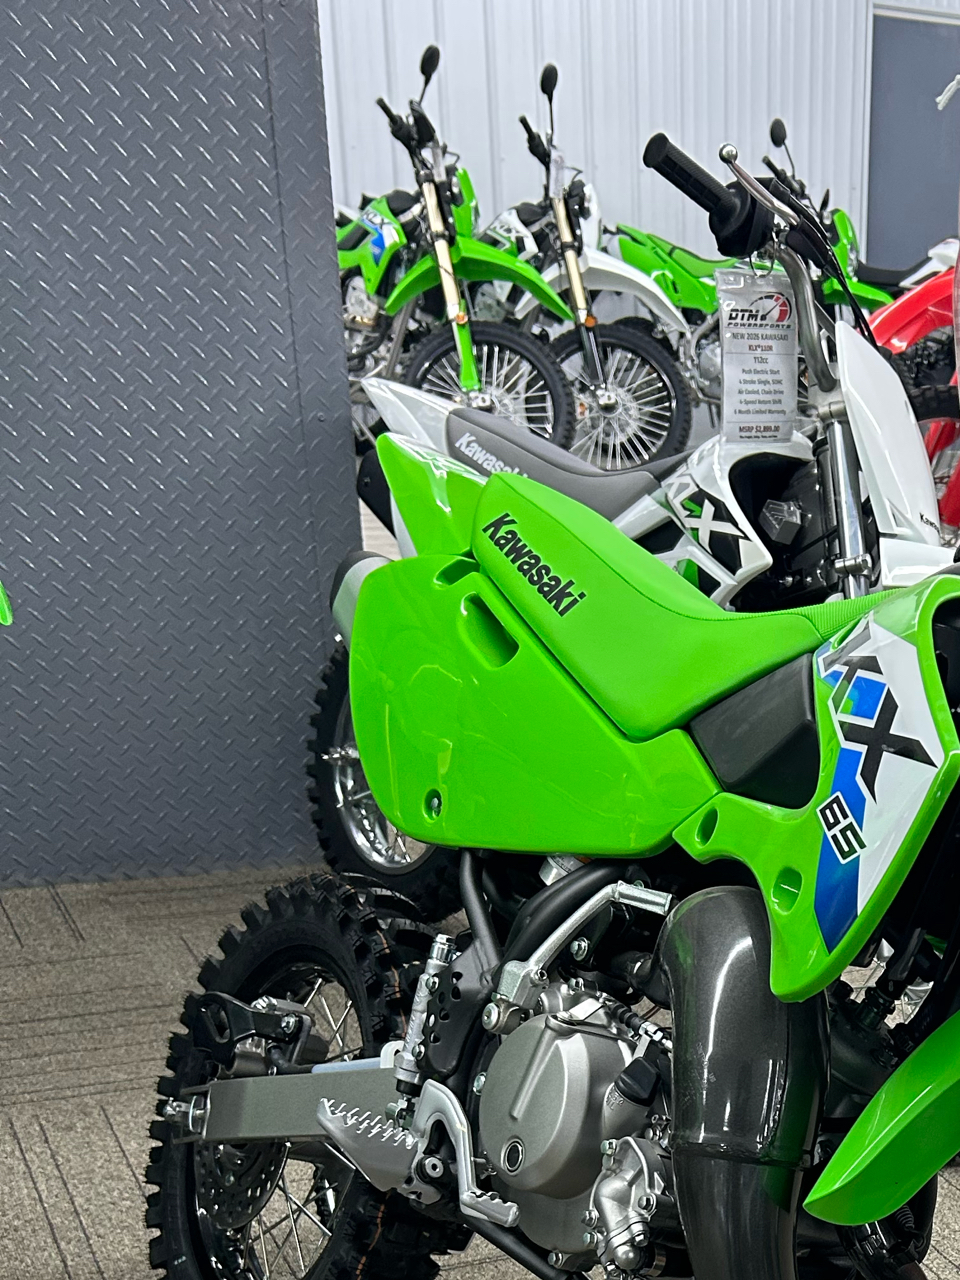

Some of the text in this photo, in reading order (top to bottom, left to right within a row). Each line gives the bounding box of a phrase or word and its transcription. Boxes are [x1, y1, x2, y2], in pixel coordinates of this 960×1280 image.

[363, 208, 393, 231] KLX
[491, 220, 526, 243] KLX
[728, 308, 761, 321] DTM
[727, 321, 792, 329] POWERSPORTS
[732, 332, 746, 340] NEW
[760, 333, 789, 341] KAWASAKI
[741, 368, 781, 376] Push Electric Start
[768, 408, 787, 416] Warranty
[739, 425, 755, 433] MSRP
[481, 512, 588, 618] Kawasaki
[821, 622, 940, 804] KX
[818, 794, 867, 862] 65
